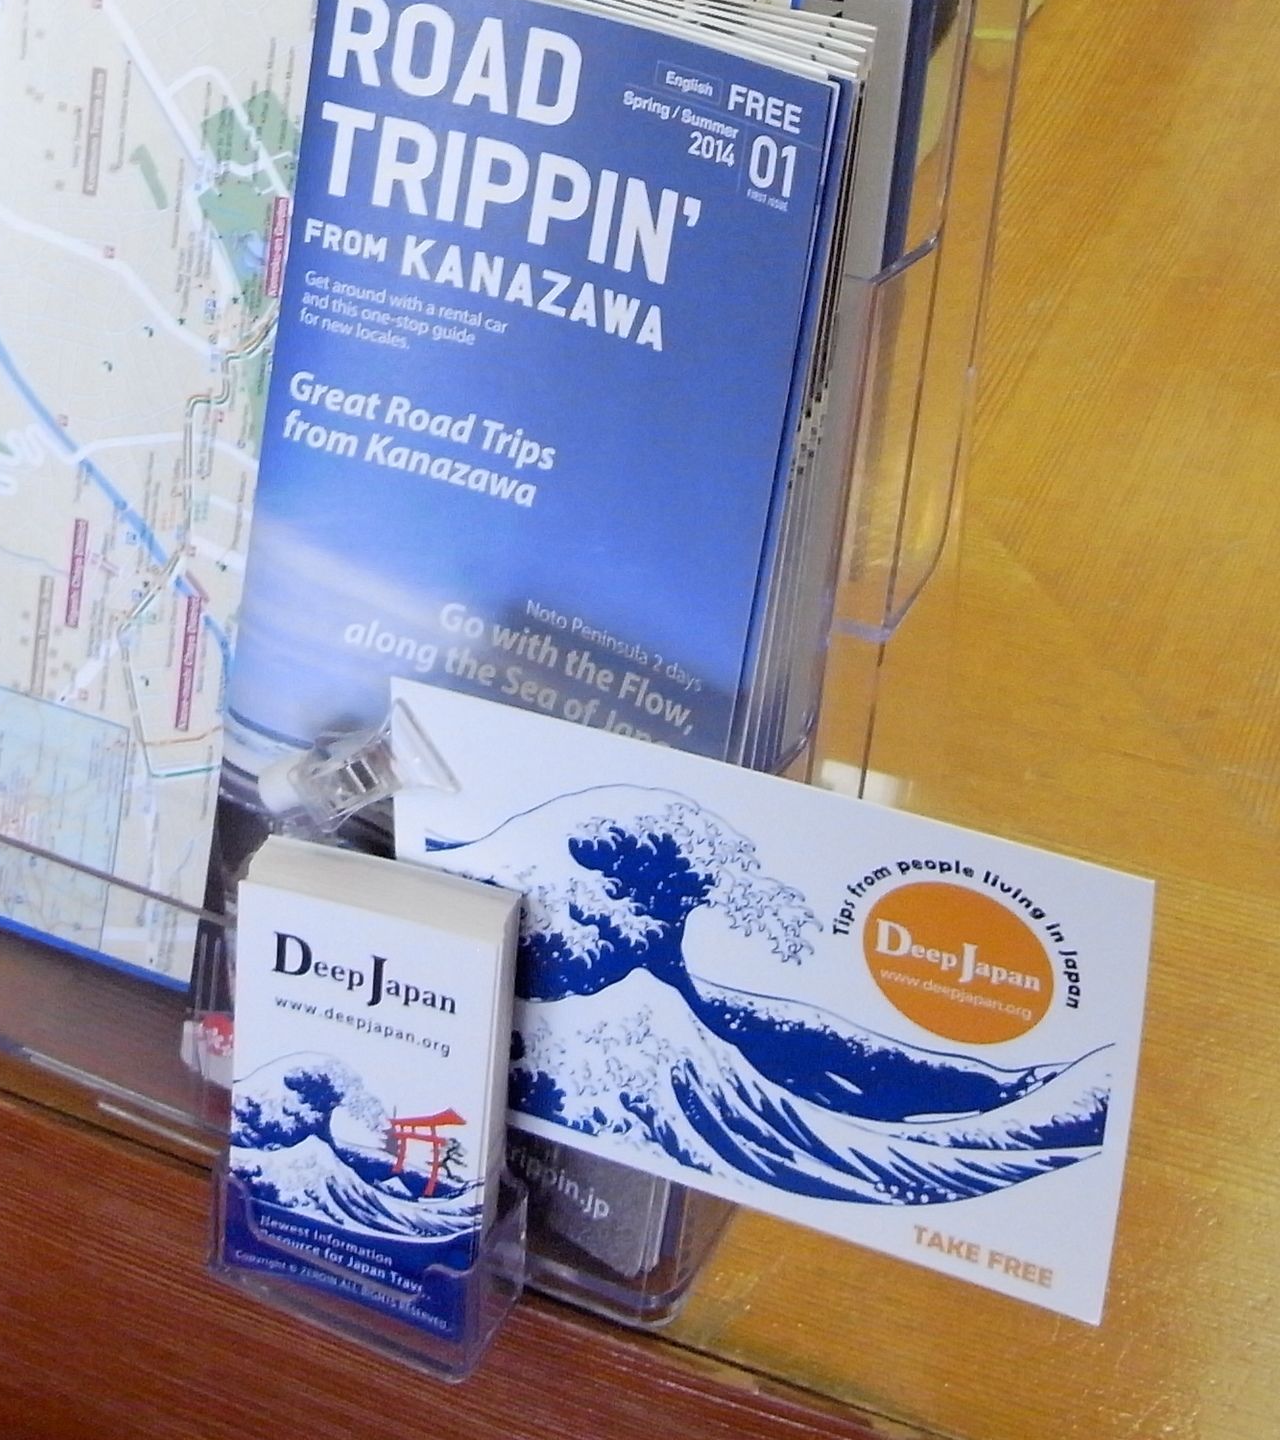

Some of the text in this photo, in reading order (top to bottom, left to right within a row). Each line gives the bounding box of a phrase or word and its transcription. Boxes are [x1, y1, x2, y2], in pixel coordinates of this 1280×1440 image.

[622, 90, 740, 140] Spring Summer
[665, 69, 803, 135] English FREE
[687, 131, 735, 168] 2014
[748, 134, 798, 199] 01
[303, 217, 386, 264] FROM
[400, 233, 665, 352] KANAZAWA
[304, 270, 509, 334] Get around with a rental car
[299, 307, 411, 350] for new locales.
[301, 289, 476, 346] and this one-stop guide
[289, 370, 557, 471] Great Road Trips
[282, 409, 538, 508] from Kanazawa
[343, 618, 604, 727] along the Sea of
[439, 602, 485, 641] Go
[490, 622, 560, 669] with
[564, 650, 615, 693] the
[618, 671, 695, 736] Flow,
[526, 599, 704, 694] Noto Peninsula 2 days
[832, 858, 1082, 1010] Tips from people living in Japan
[274, 994, 453, 1058] www.deepjapan.org
[878, 967, 1034, 1022] www.deepjapan.org
[313, 1230, 394, 1267] Information
[323, 1246, 387, 1281] for Japan
[912, 1223, 1055, 1291] TAKE FREE
